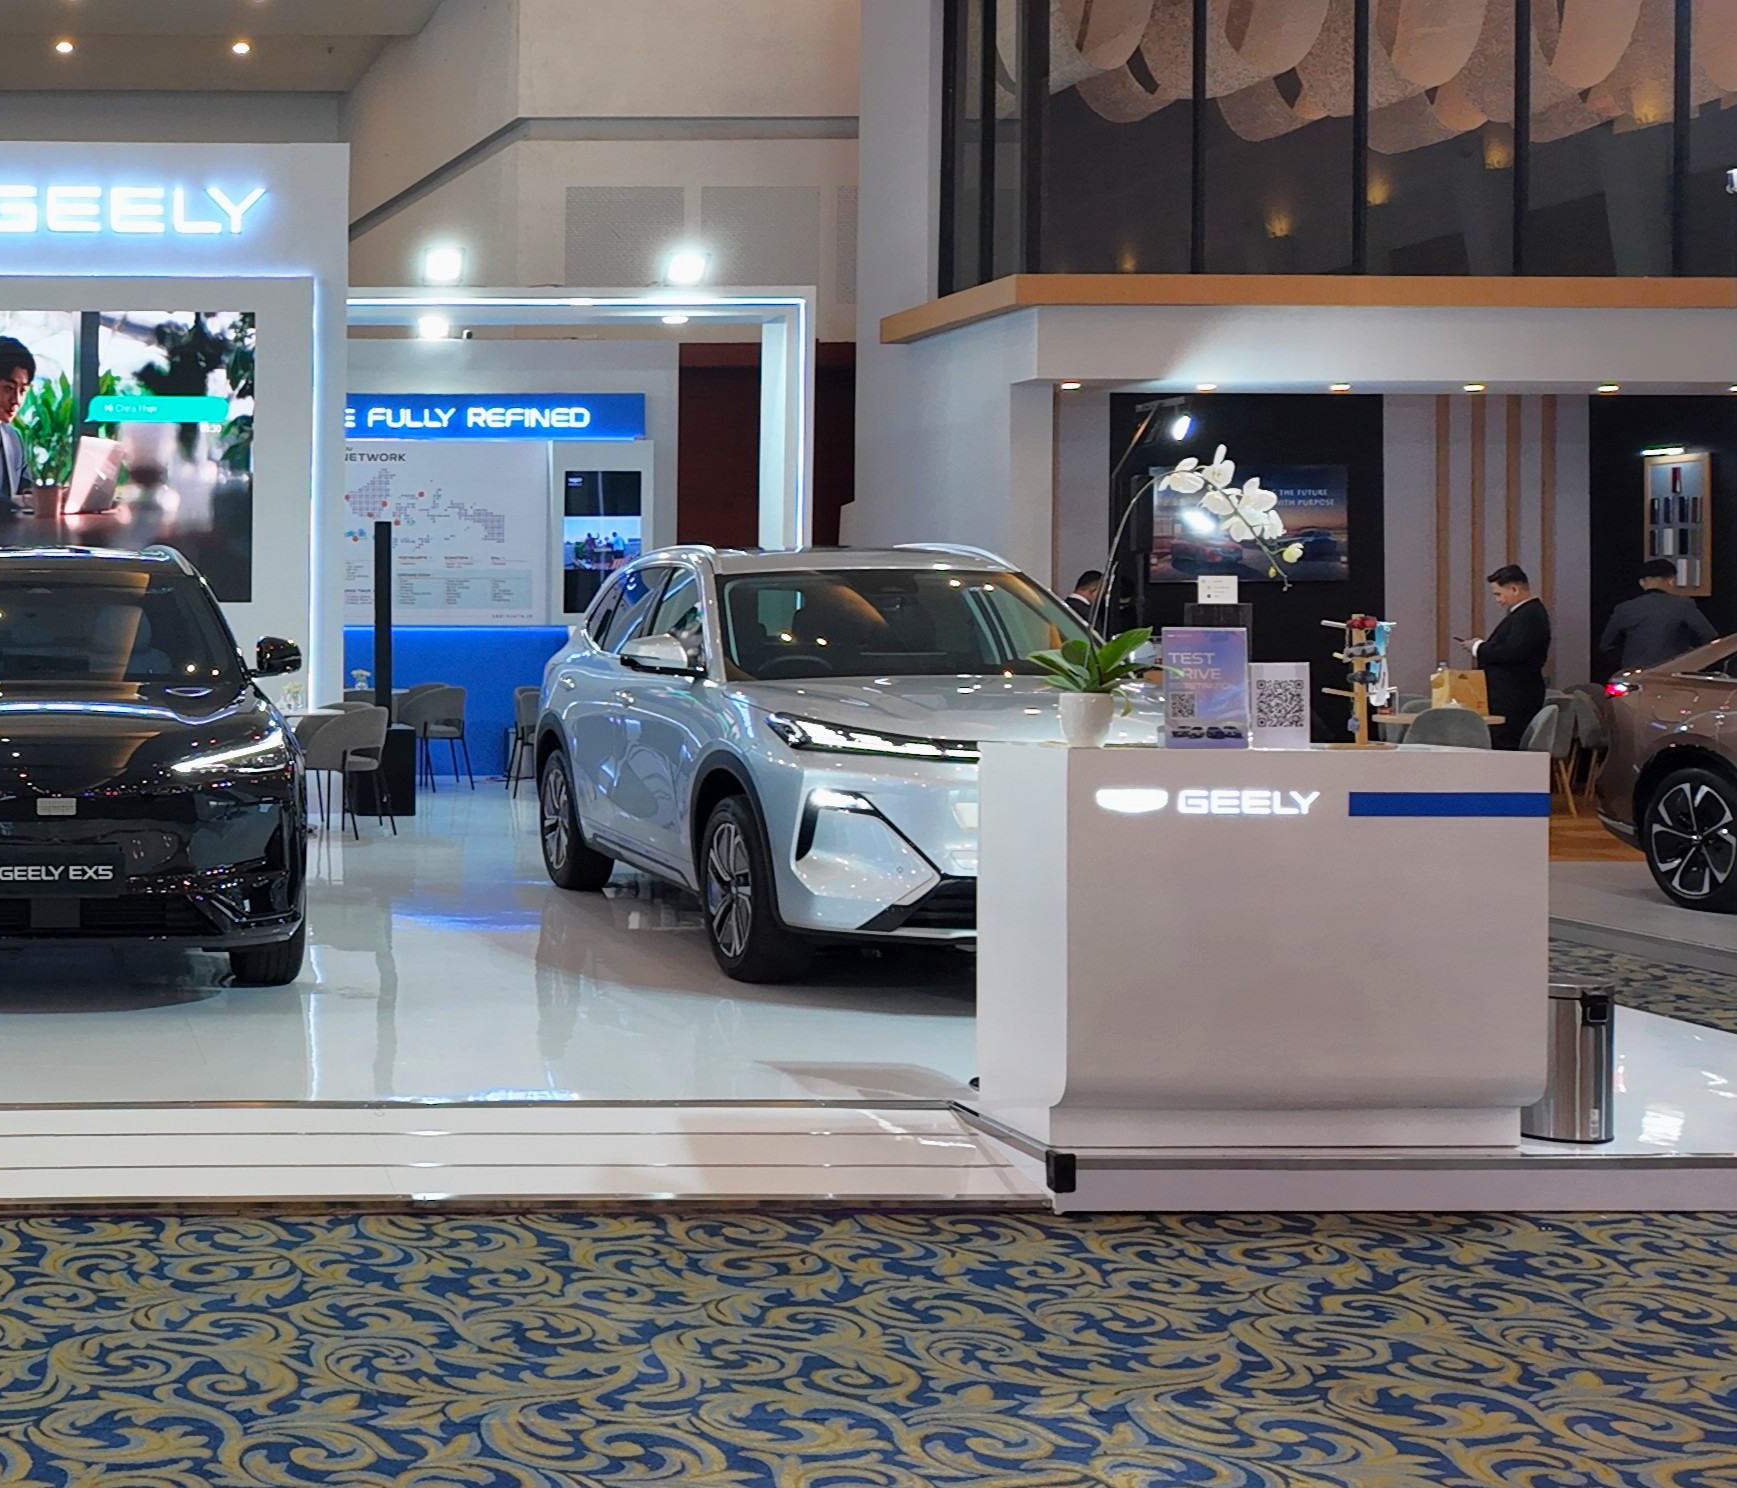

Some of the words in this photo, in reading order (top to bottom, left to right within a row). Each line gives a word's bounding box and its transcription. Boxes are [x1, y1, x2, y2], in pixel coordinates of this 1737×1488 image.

[367, 407, 456, 428] FULLY
[466, 407, 591, 428] REFINED
[1168, 652, 1215, 664] TEST
[1177, 789, 1321, 815] GEELY
[68, 865, 114, 880] EX5
